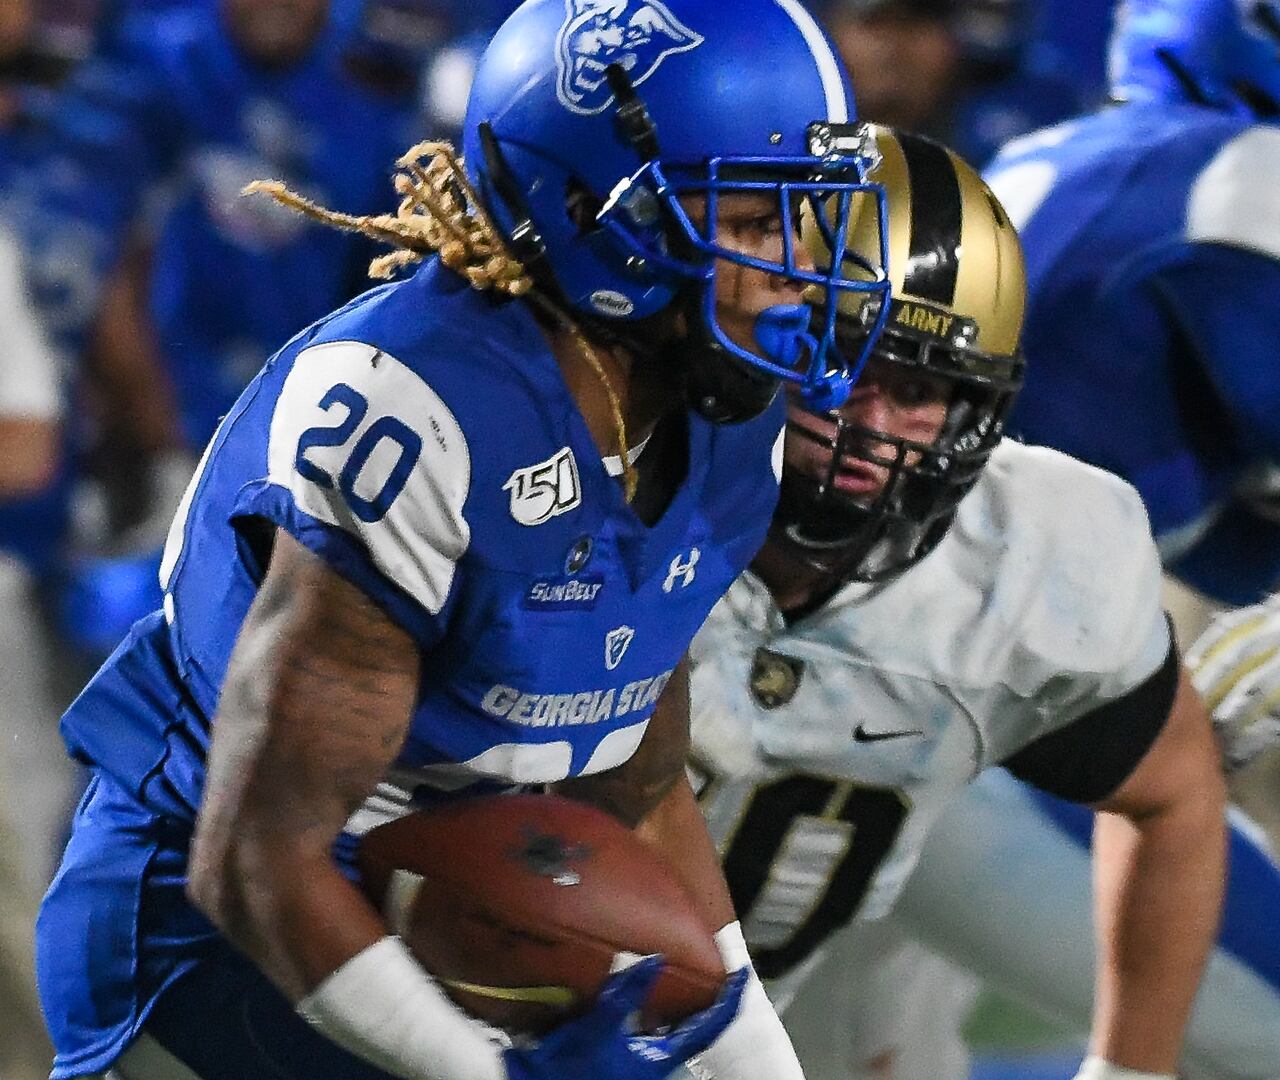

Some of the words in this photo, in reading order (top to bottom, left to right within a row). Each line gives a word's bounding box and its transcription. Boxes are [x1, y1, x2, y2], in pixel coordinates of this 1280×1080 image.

[895, 302, 953, 338] ARMY
[295, 382, 425, 524] 20
[505, 449, 580, 525] 150
[480, 683, 617, 728] GEORGIA
[615, 669, 674, 718] STA
